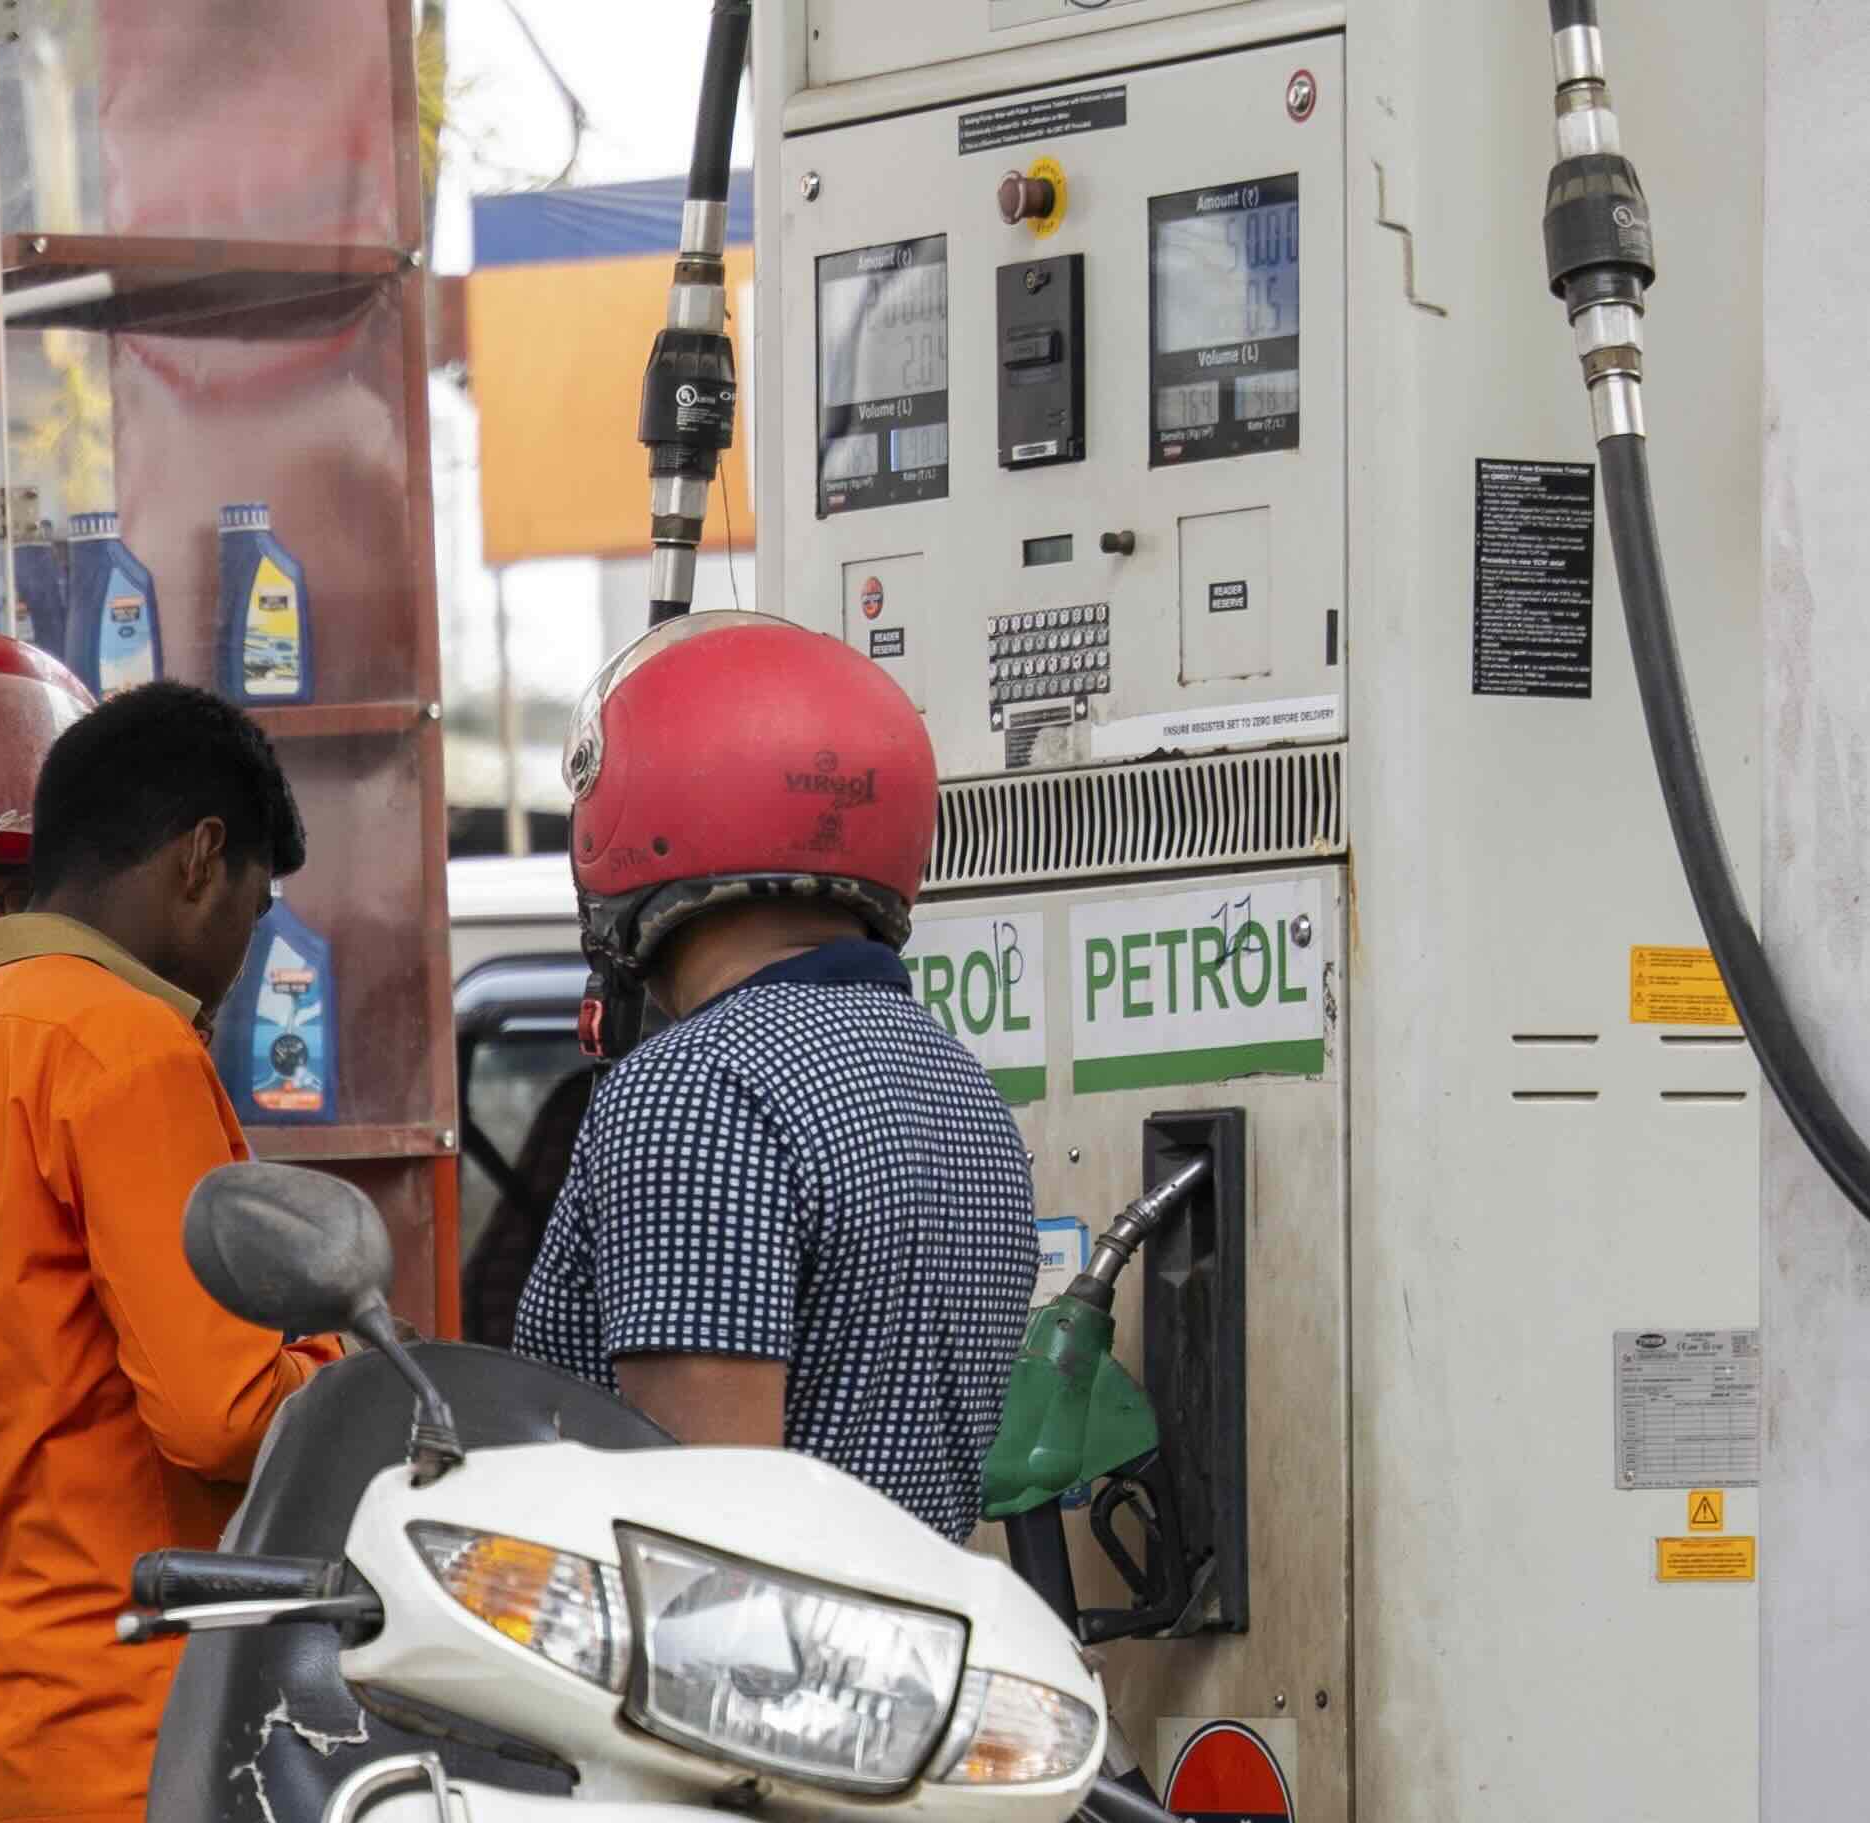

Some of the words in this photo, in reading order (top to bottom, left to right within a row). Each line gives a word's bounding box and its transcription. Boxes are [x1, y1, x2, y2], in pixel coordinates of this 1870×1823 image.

[1196, 190, 1240, 211] Amount
[1197, 349, 1240, 368] Volume
[859, 402, 896, 421] Volume
[1213, 584, 1243, 597] READER
[1212, 597, 1244, 609] RESERVE
[1162, 723, 1190, 737] ENSURE
[1226, 718, 1240, 730] SET
[1241, 717, 1251, 728] TO
[1272, 711, 1300, 726] BEFORE
[1300, 708, 1335, 723] DELIVERY
[1084, 919, 1308, 1023] PETROL
